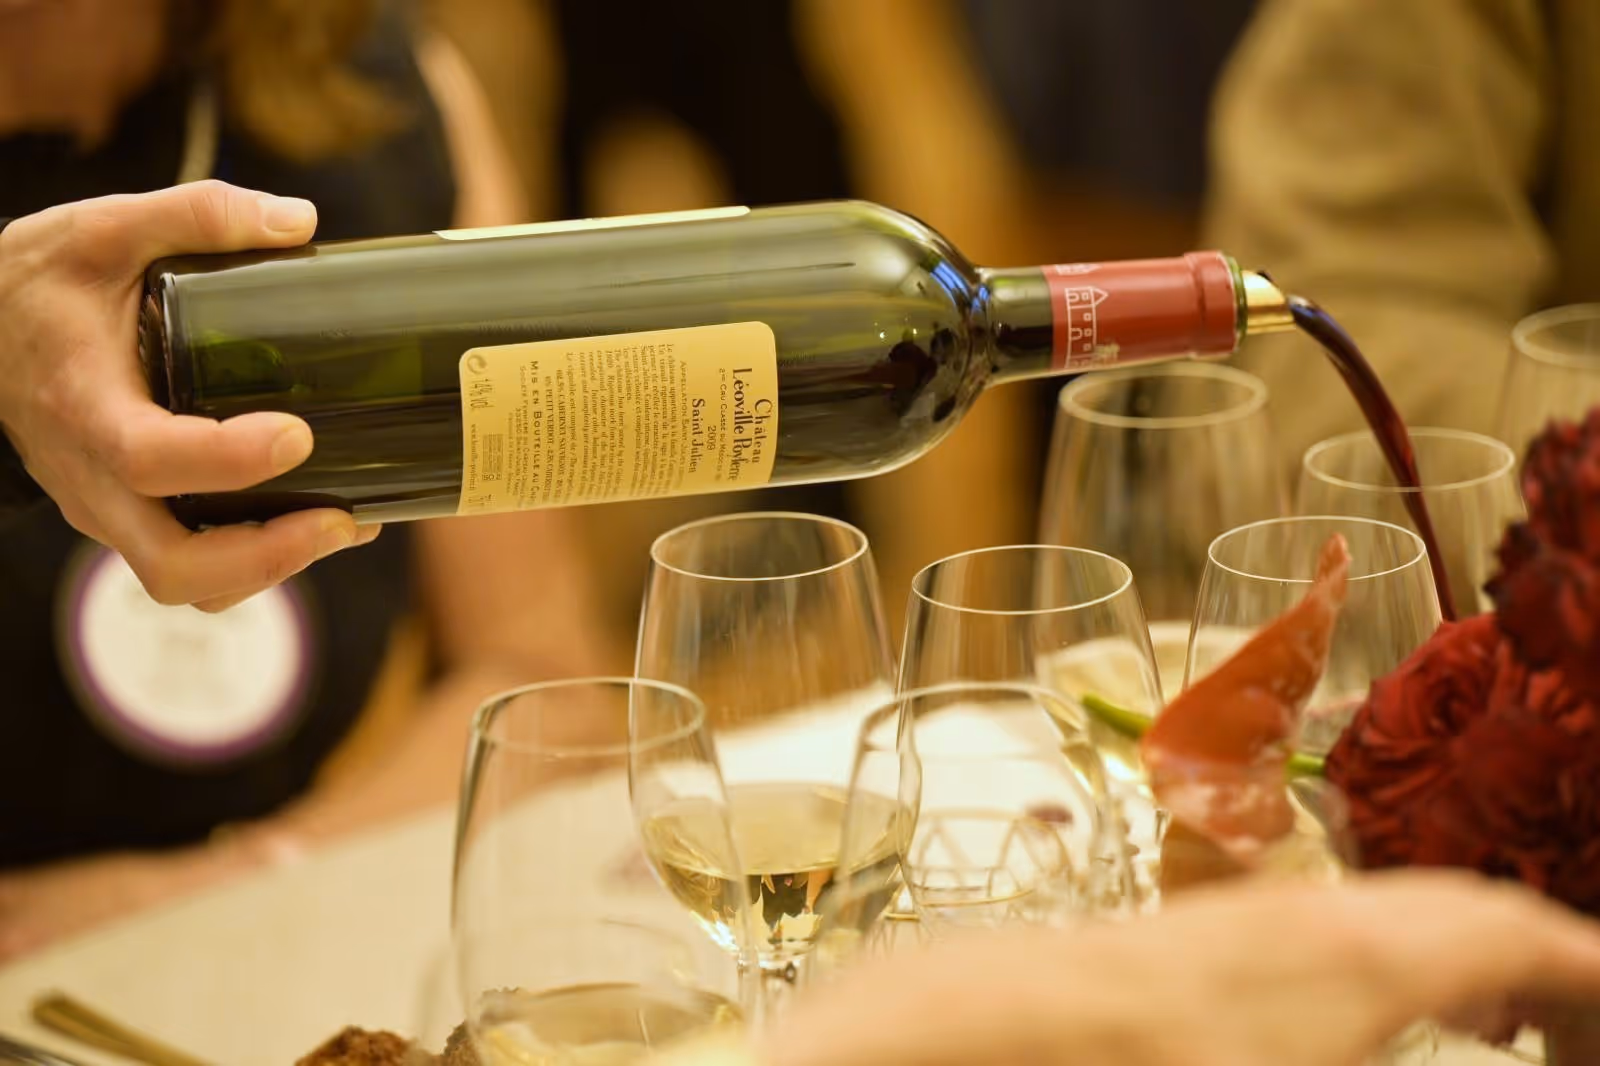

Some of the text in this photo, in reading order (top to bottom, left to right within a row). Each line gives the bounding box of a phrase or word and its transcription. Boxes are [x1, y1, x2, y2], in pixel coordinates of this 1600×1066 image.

[733, 368, 754, 435] Léoville
[750, 398, 773, 464] Château
[534, 411, 543, 470] BOUTEILLE
[688, 398, 705, 473] Saint Julien
